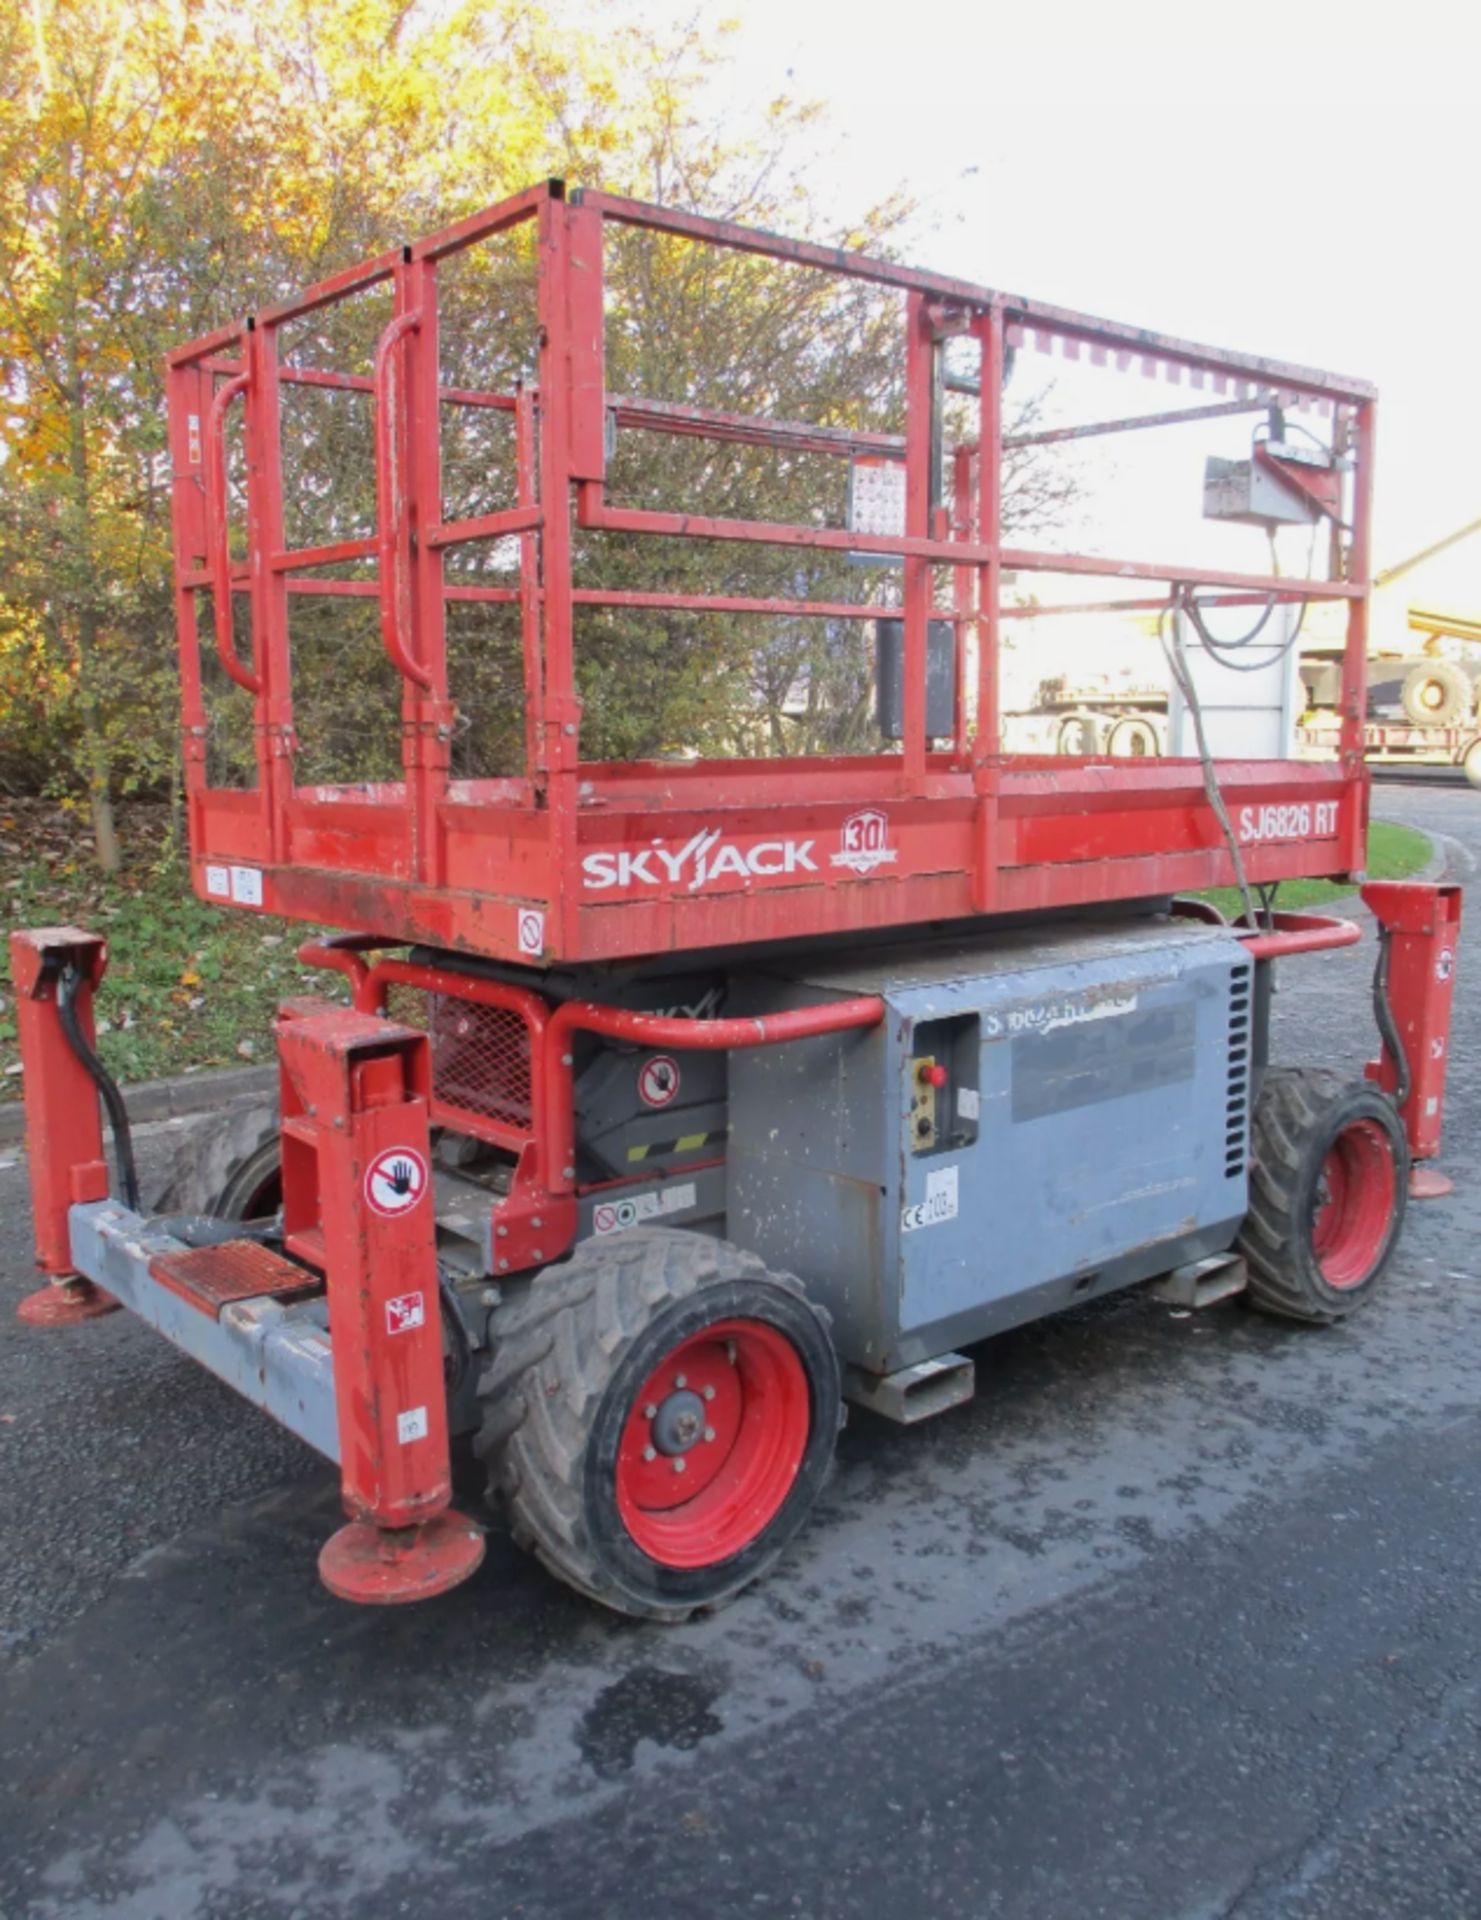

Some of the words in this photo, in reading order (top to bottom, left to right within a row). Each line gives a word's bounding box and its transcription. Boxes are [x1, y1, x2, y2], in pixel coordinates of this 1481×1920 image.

[847, 818, 881, 852] 30
[1240, 804, 1309, 841] SJ6826
[1315, 800, 1339, 834] RT
[581, 826, 818, 892] SKYJACK
